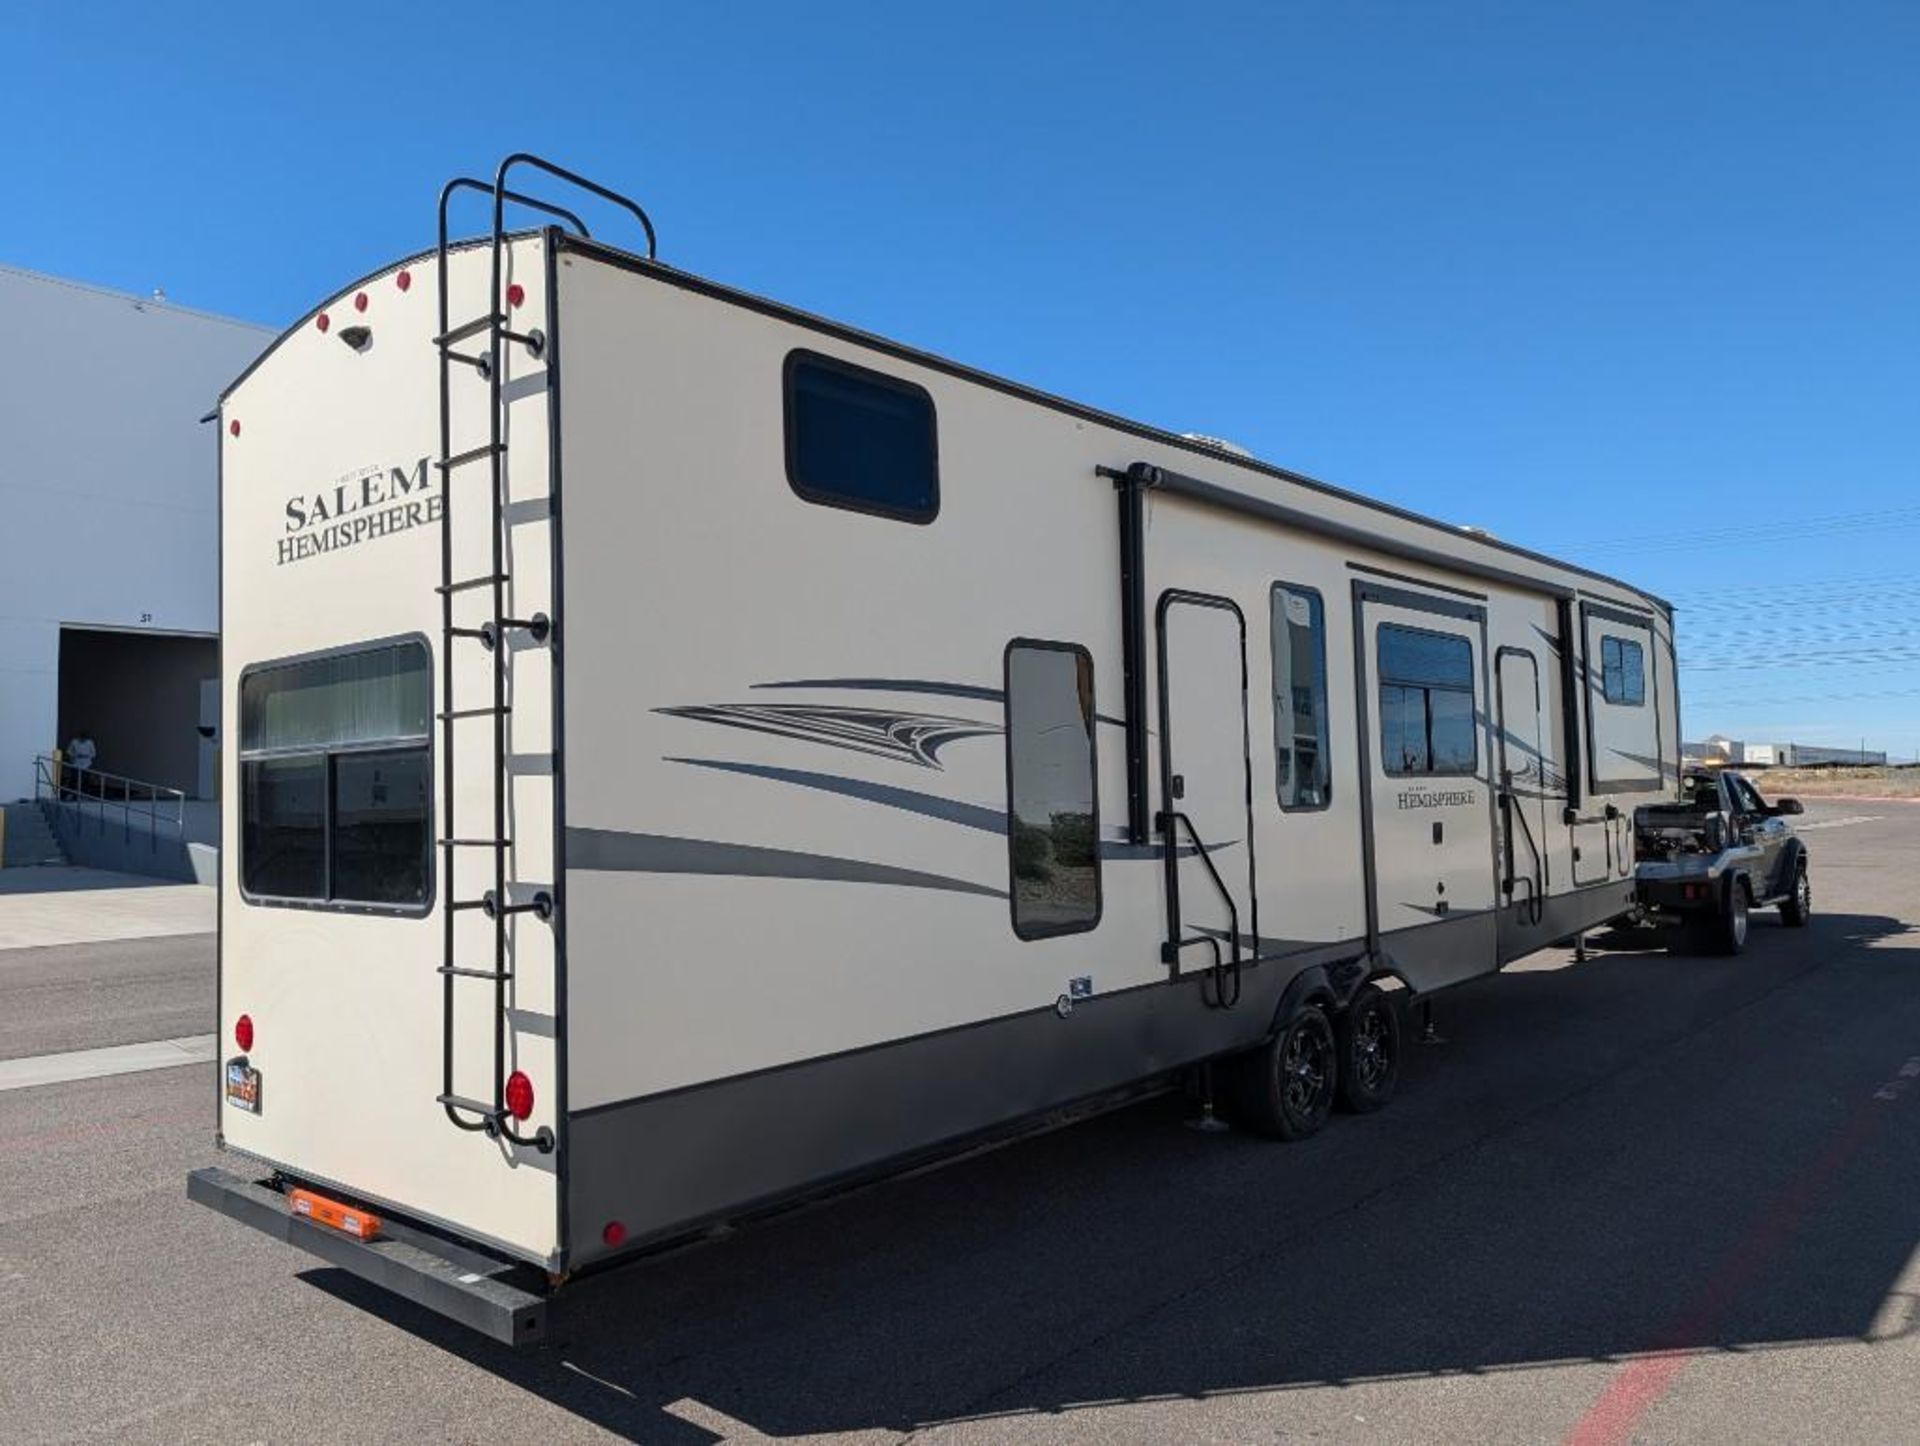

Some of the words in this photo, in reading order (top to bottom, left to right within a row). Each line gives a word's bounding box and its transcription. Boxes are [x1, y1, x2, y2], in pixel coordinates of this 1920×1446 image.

[276, 494, 443, 566] HEMISPHERE
[285, 455, 432, 533] SALEM
[1397, 790, 1475, 810] HEMISPHERE
